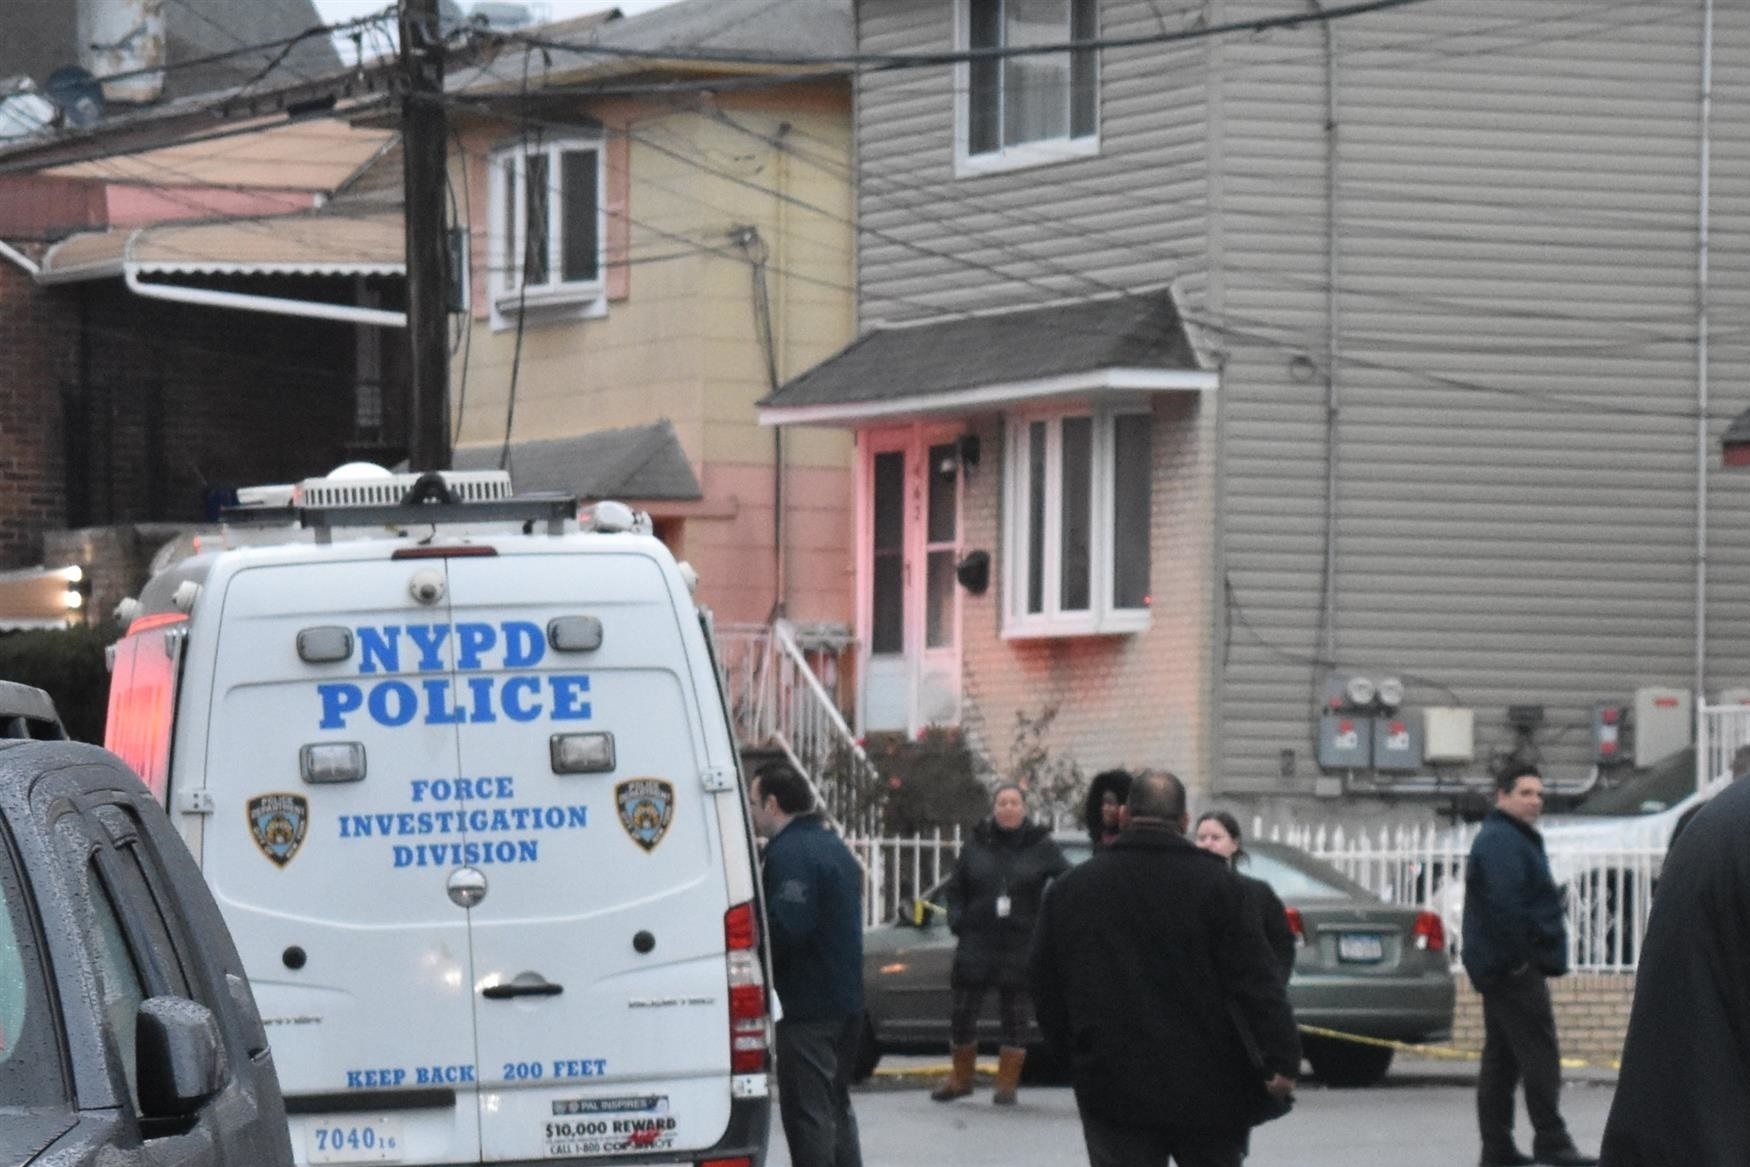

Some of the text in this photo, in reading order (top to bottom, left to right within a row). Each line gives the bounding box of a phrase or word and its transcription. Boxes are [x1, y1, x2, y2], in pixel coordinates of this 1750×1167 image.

[356, 621, 546, 674] NYPD
[316, 675, 592, 729] POLICE
[411, 776, 514, 801] FORCE
[338, 806, 588, 837] INVESTIGATION
[393, 840, 538, 868] DIVISION
[346, 1059, 607, 1088] KEEP BACK 200 FEET
[316, 1126, 375, 1150] 7040
[546, 1121, 607, 1139] $10,000
[613, 1117, 677, 1133] REWARD
[550, 1144, 572, 1154] CALL
